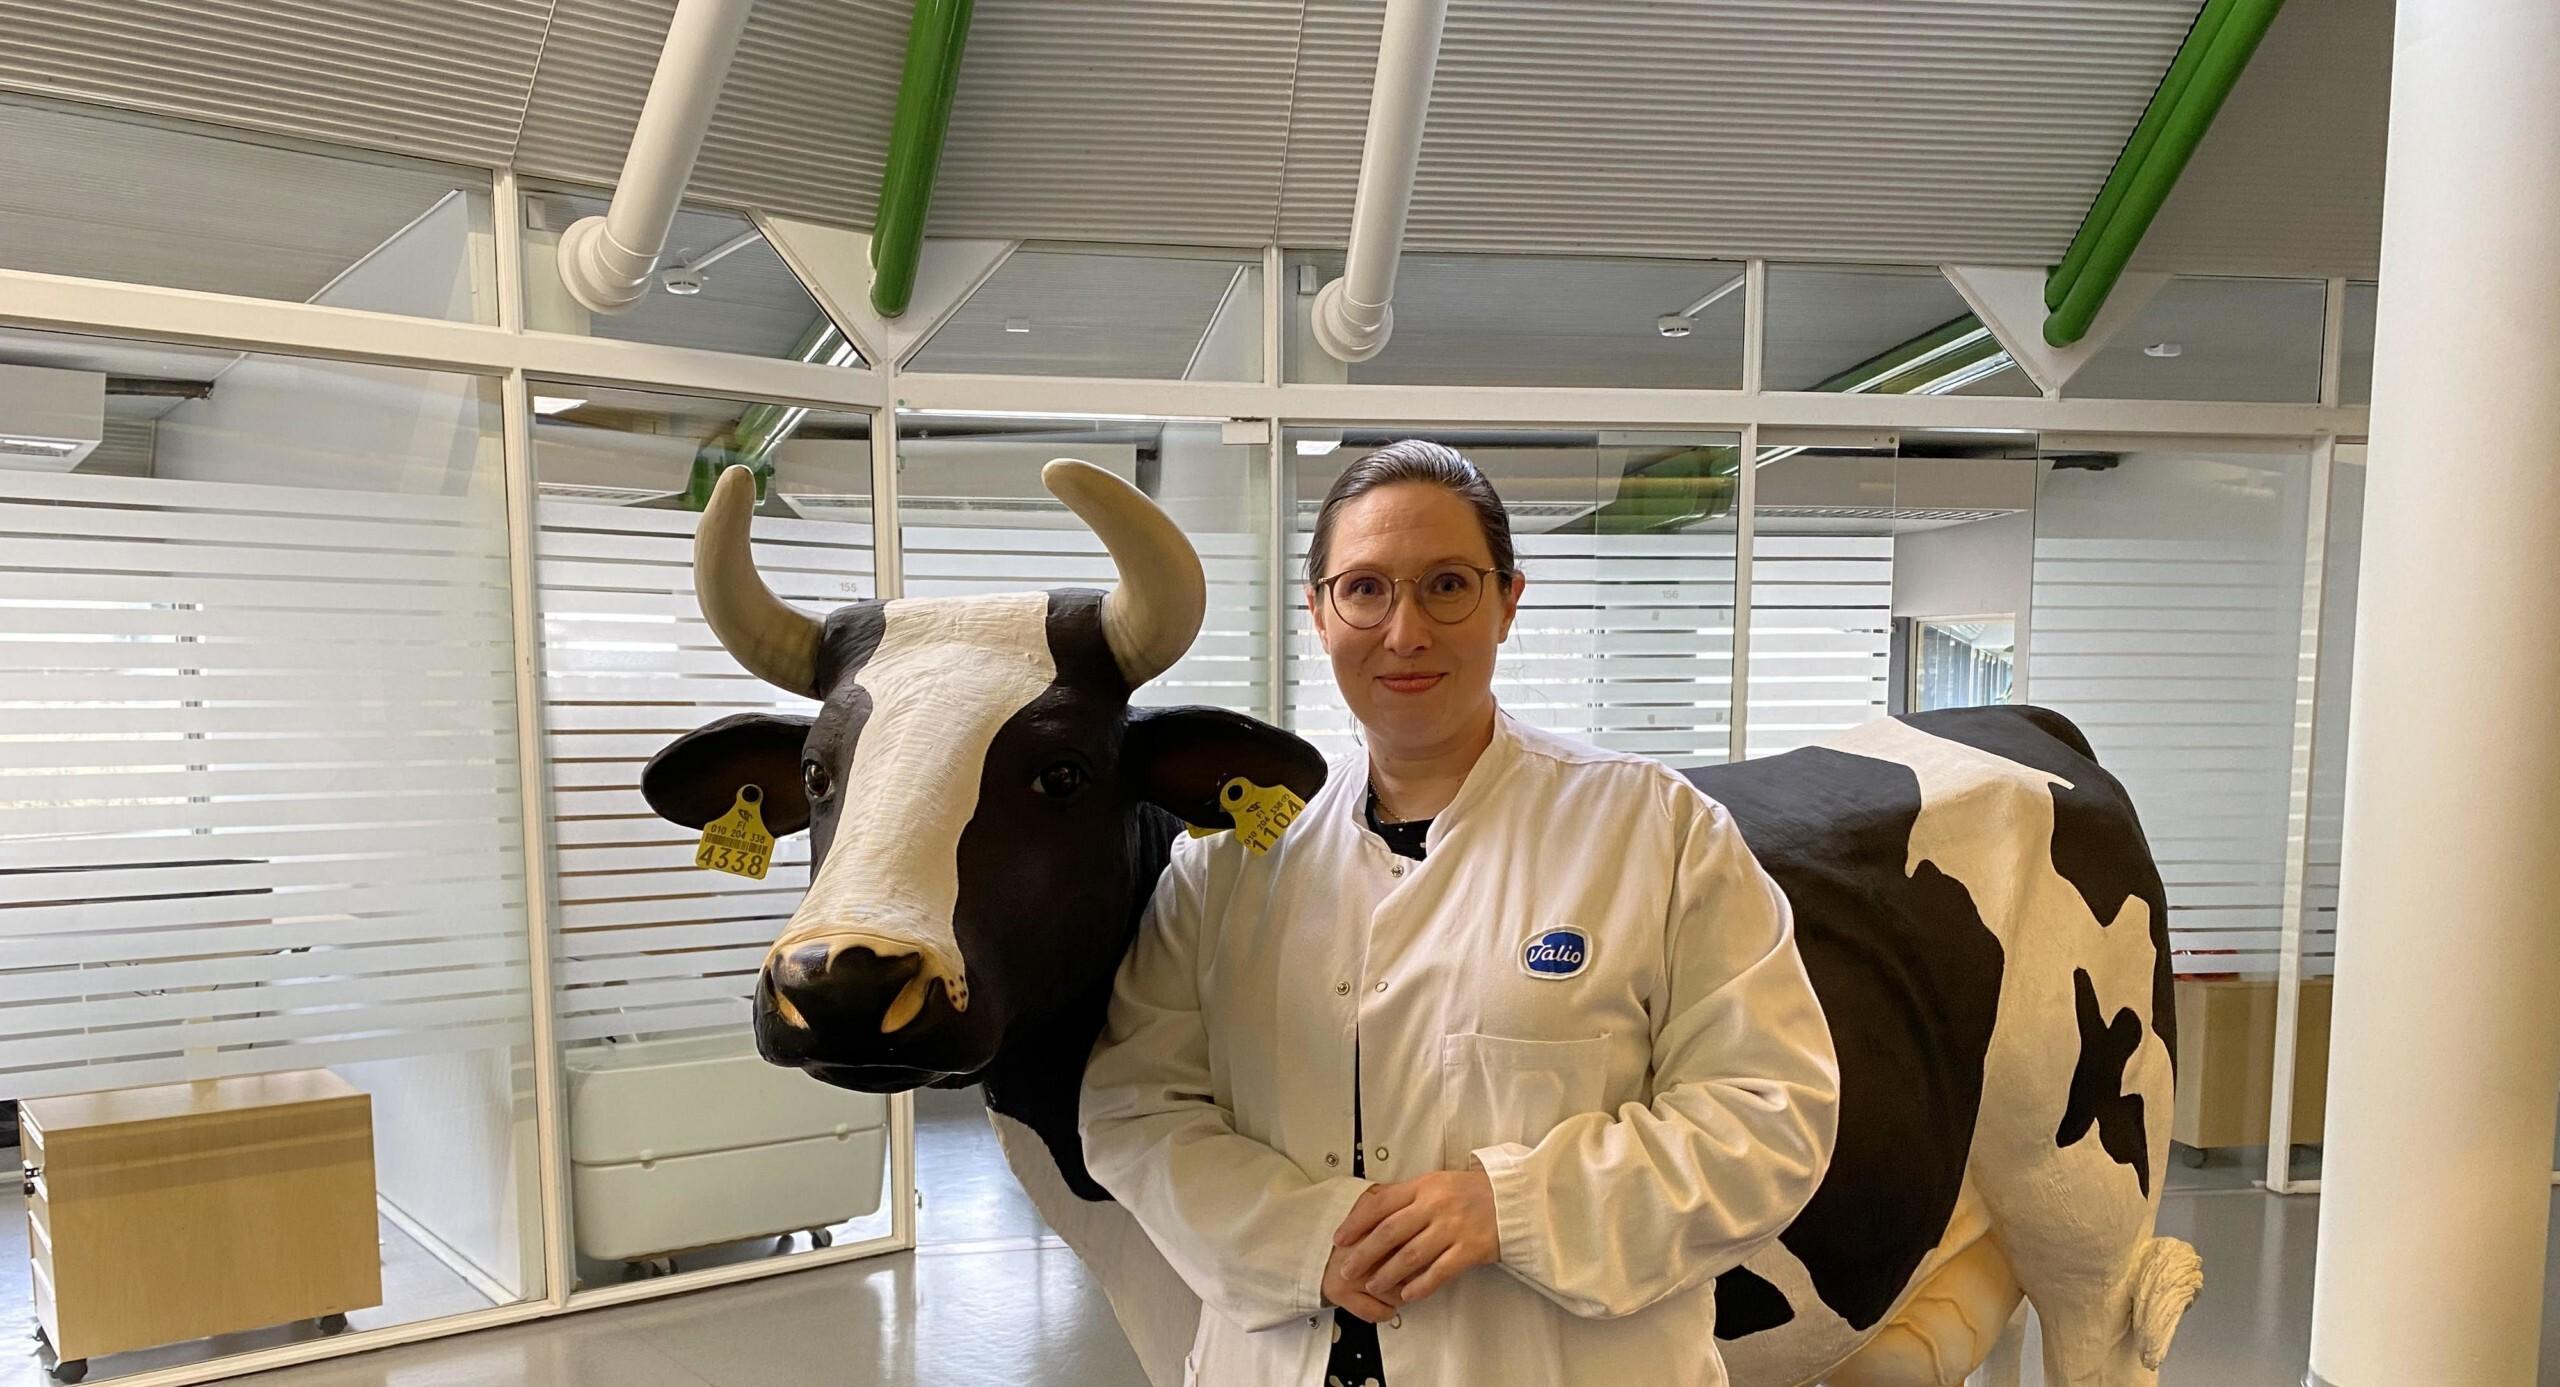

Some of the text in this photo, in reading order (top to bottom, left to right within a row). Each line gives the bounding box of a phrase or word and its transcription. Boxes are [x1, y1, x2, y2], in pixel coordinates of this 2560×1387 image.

[1252, 799, 1302, 852] 1104
[698, 844, 763, 876] 4338
[1528, 944, 1581, 964] Valio
